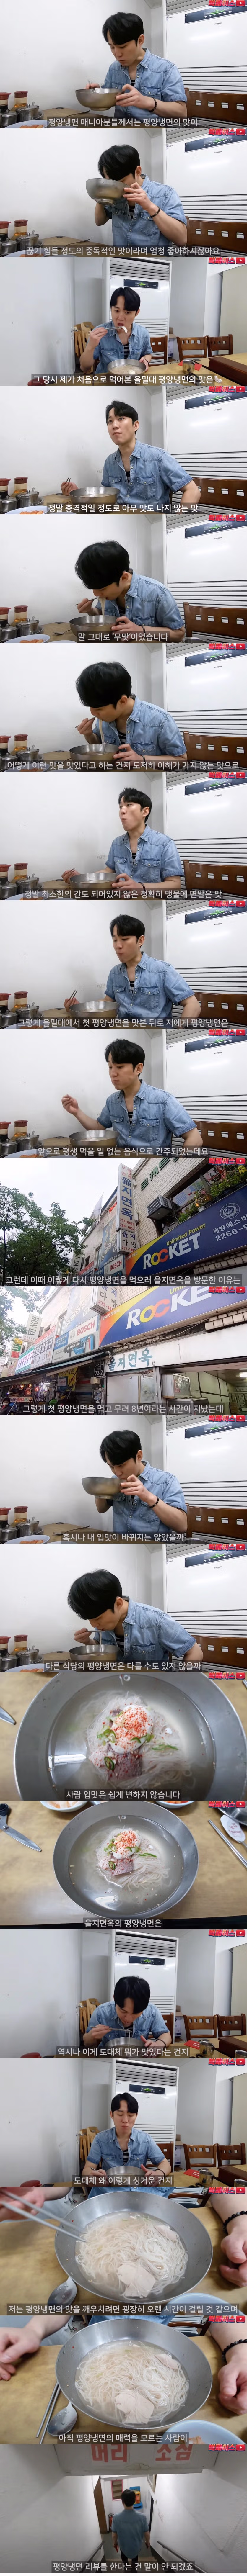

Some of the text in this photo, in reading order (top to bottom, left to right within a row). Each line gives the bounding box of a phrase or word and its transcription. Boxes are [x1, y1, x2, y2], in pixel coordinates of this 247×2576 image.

[120, 1176, 134, 1220] 을지면옥
[122, 1231, 135, 1240] 을지
[166, 1223, 206, 1246] Unlimited Power
[122, 1239, 136, 1248] 다방
[143, 1232, 201, 1269] ROCKET
[110, 1259, 122, 1271] BOSCH
[98, 1300, 113, 1310] 272-18
[100, 1290, 118, 1307] 다방
[77, 1320, 95, 1336] BOSCH
[107, 1348, 152, 1371] 을지면옥
